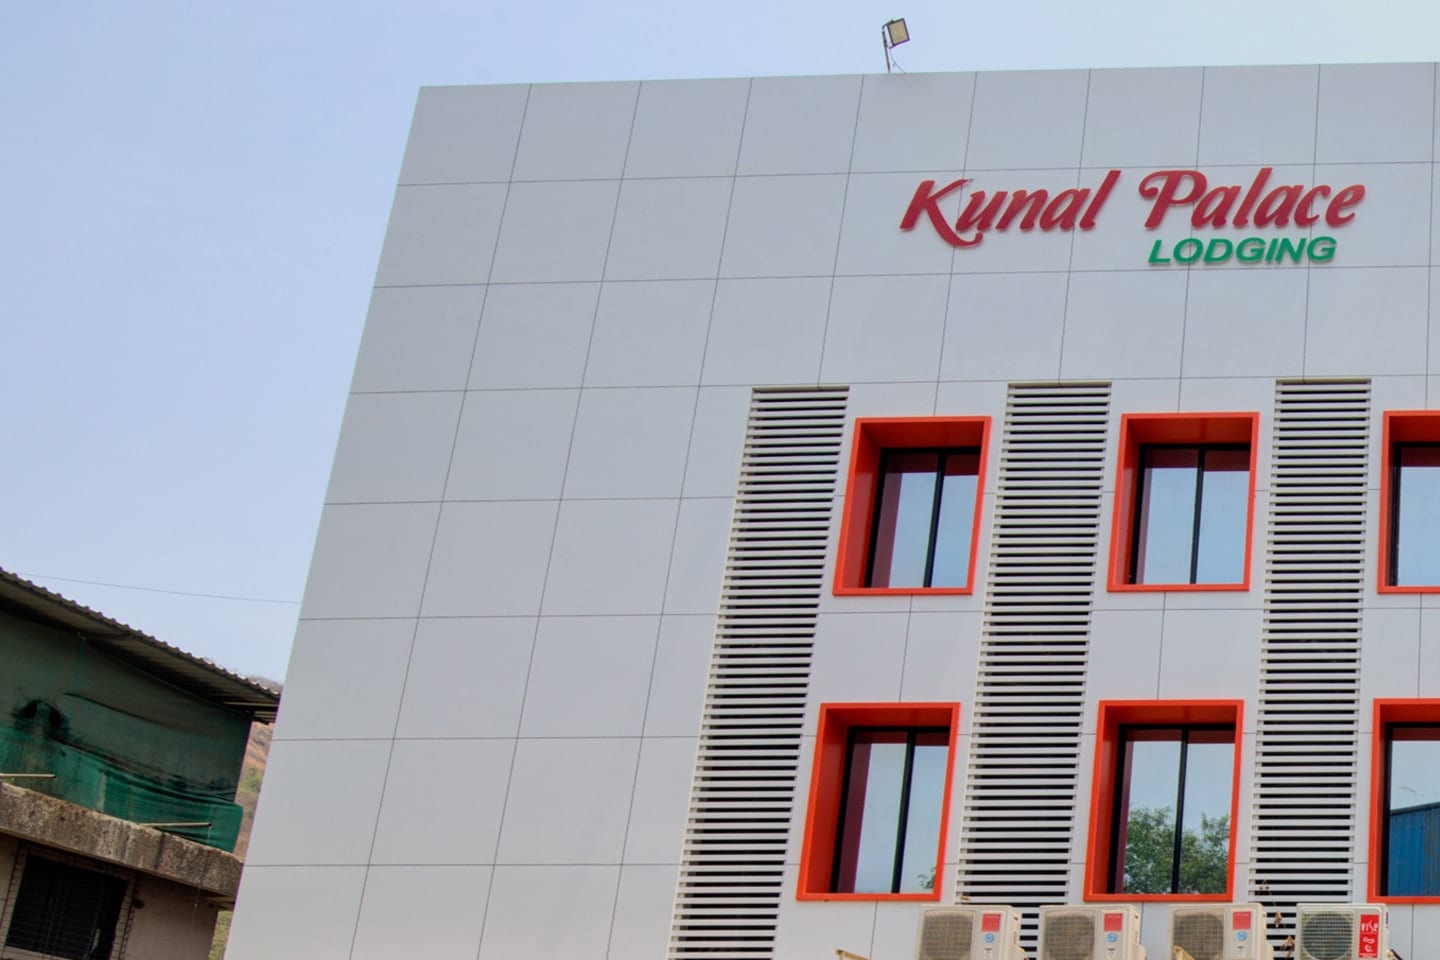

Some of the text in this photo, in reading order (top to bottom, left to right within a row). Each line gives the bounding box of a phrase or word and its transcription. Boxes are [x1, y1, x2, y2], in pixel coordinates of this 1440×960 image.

[900, 167, 1366, 247] Kunal Palace
[1148, 235, 1337, 265] LODGING
